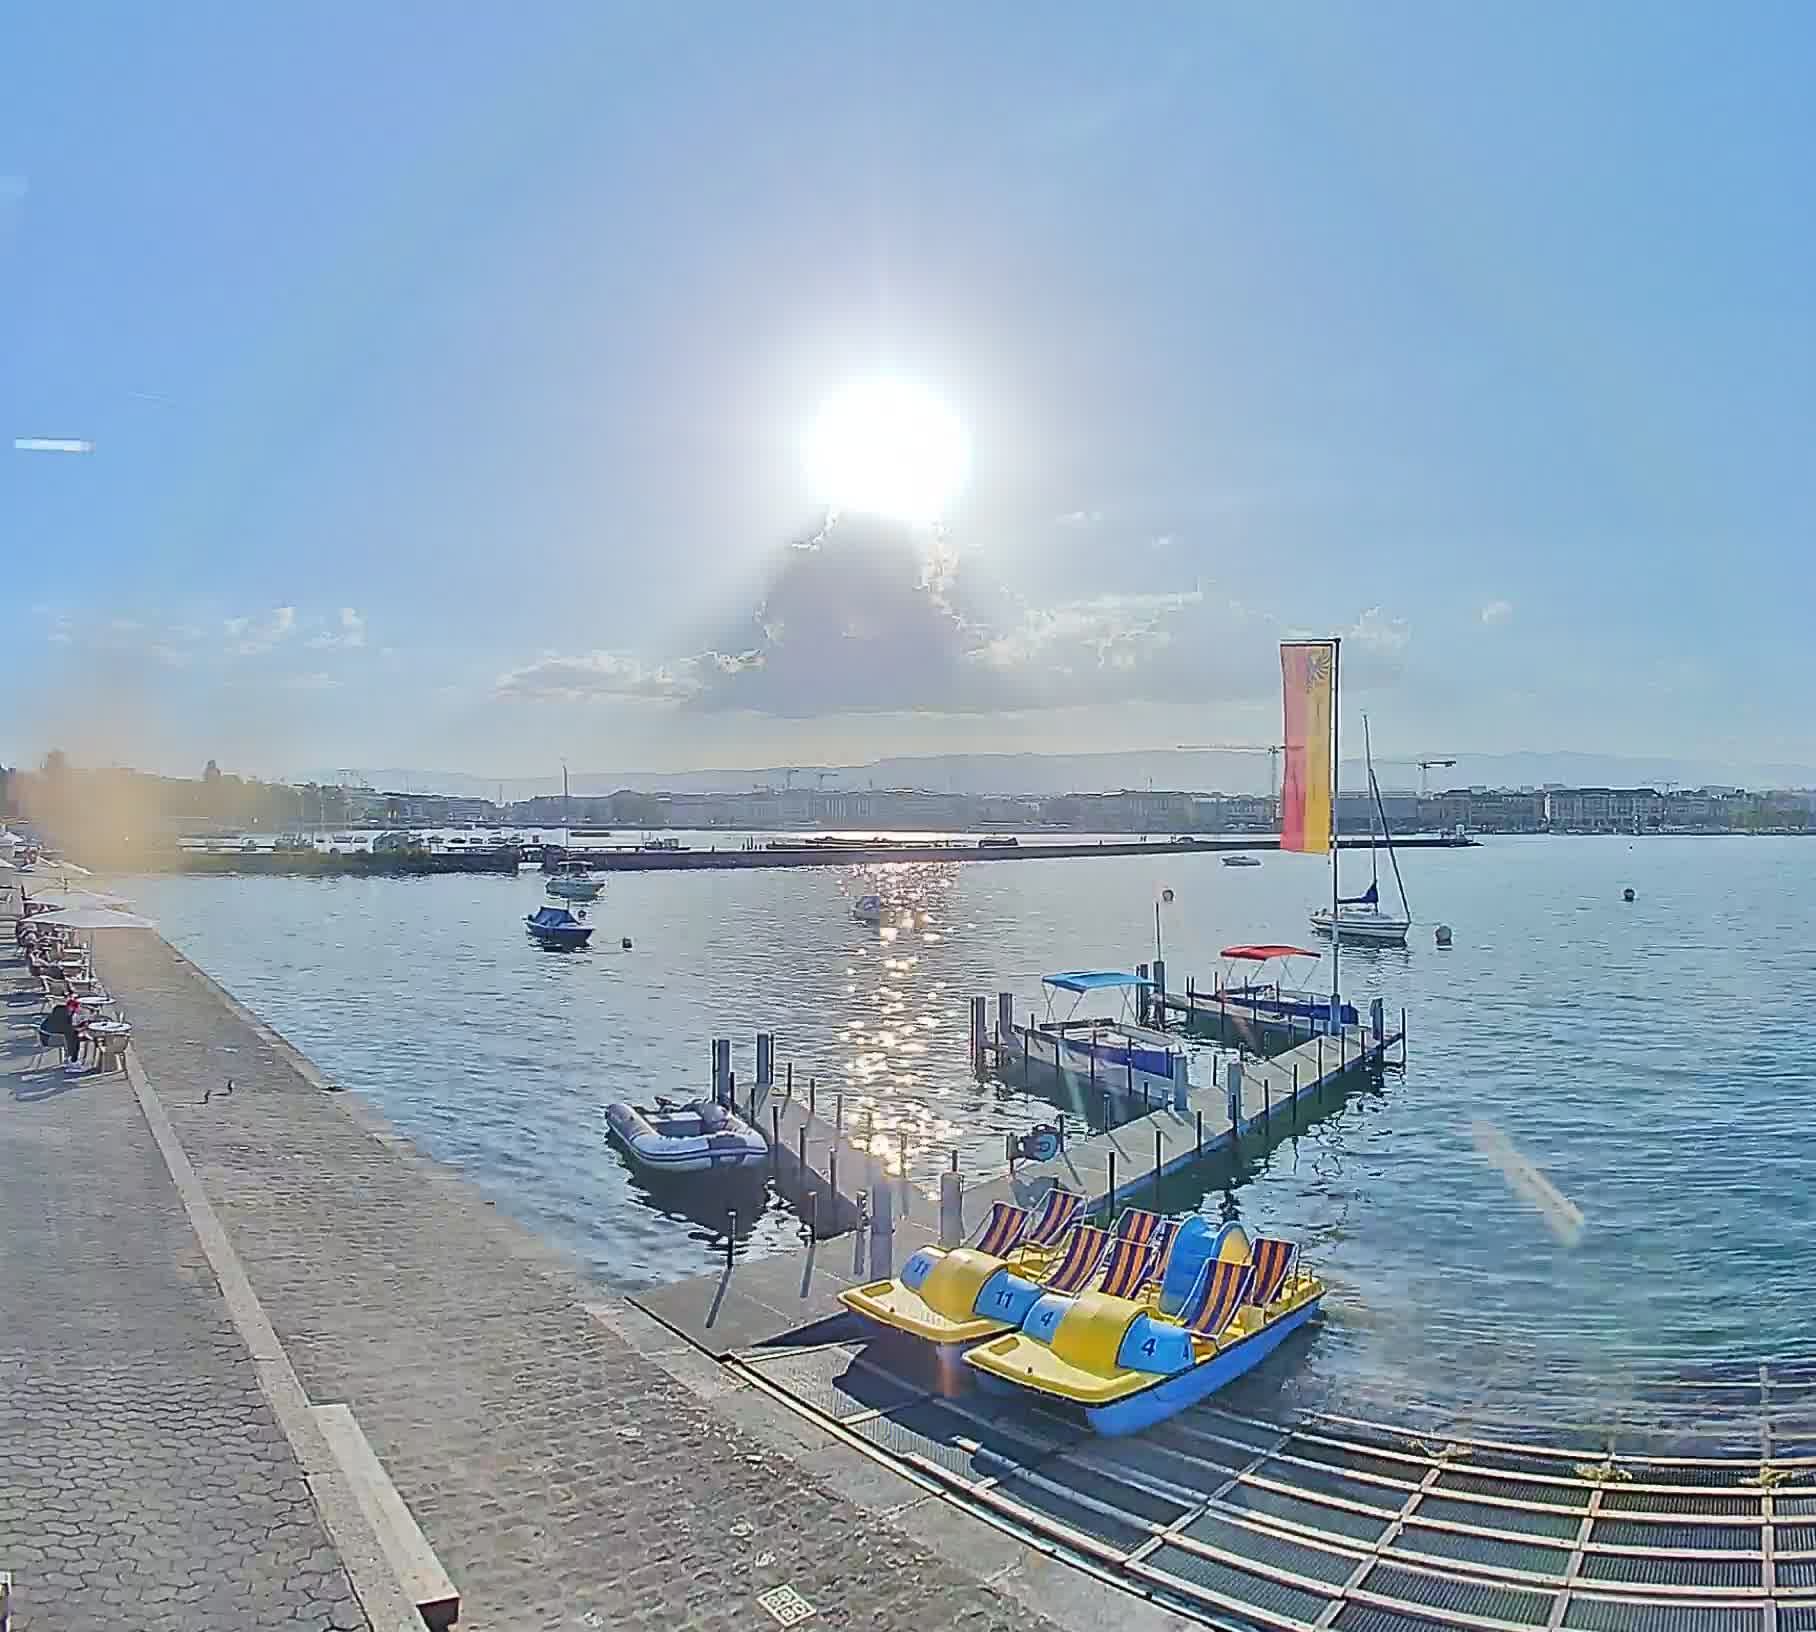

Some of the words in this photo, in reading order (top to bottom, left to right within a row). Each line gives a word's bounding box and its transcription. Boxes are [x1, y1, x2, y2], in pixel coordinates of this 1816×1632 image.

[995, 1291, 1014, 1309] 11
[1039, 1311, 1054, 1327] 4
[1141, 1338, 1157, 1357] 4
